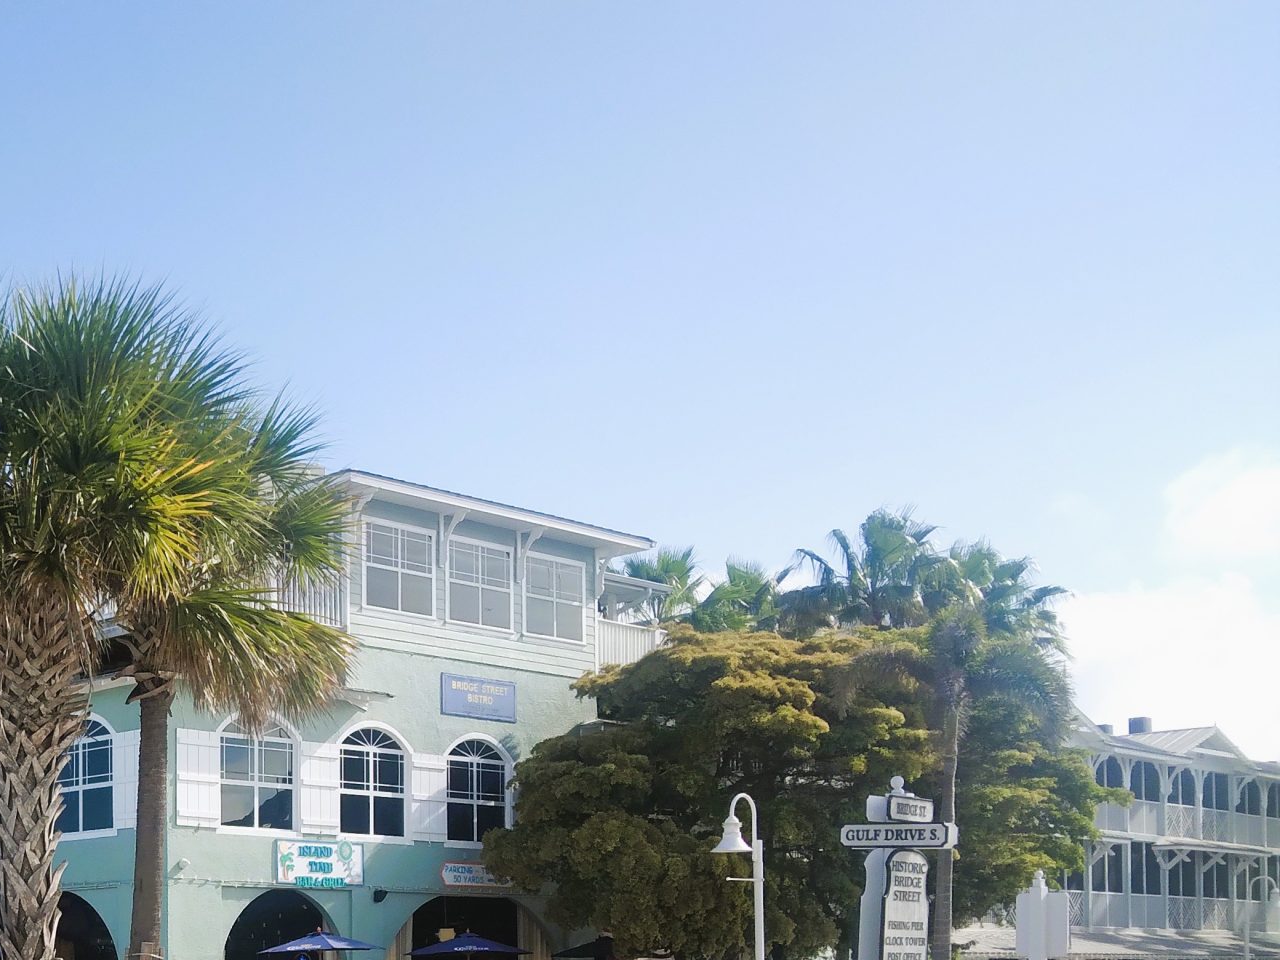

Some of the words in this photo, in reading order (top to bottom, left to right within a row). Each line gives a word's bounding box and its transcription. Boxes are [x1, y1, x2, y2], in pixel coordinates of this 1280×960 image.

[451, 680, 479, 692] BRIDGE
[481, 685, 508, 696] STREET
[467, 693, 493, 705] BISTRO
[896, 803, 918, 816] BRIDGE
[845, 829, 882, 841] GULF
[884, 829, 926, 841] DRIVE
[929, 829, 940, 841] S.
[298, 846, 333, 858] ISLAND
[892, 861, 926, 874] HISTORIC
[894, 876, 922, 888] BRIDGE
[893, 890, 921, 902] STREET
[888, 921, 910, 930] FISHING
[911, 921, 924, 931] PIER
[885, 936, 904, 946] CLOCK
[905, 937, 926, 946] TOWER
[887, 952, 901, 960] POST
[902, 952, 922, 960] OFFICE
